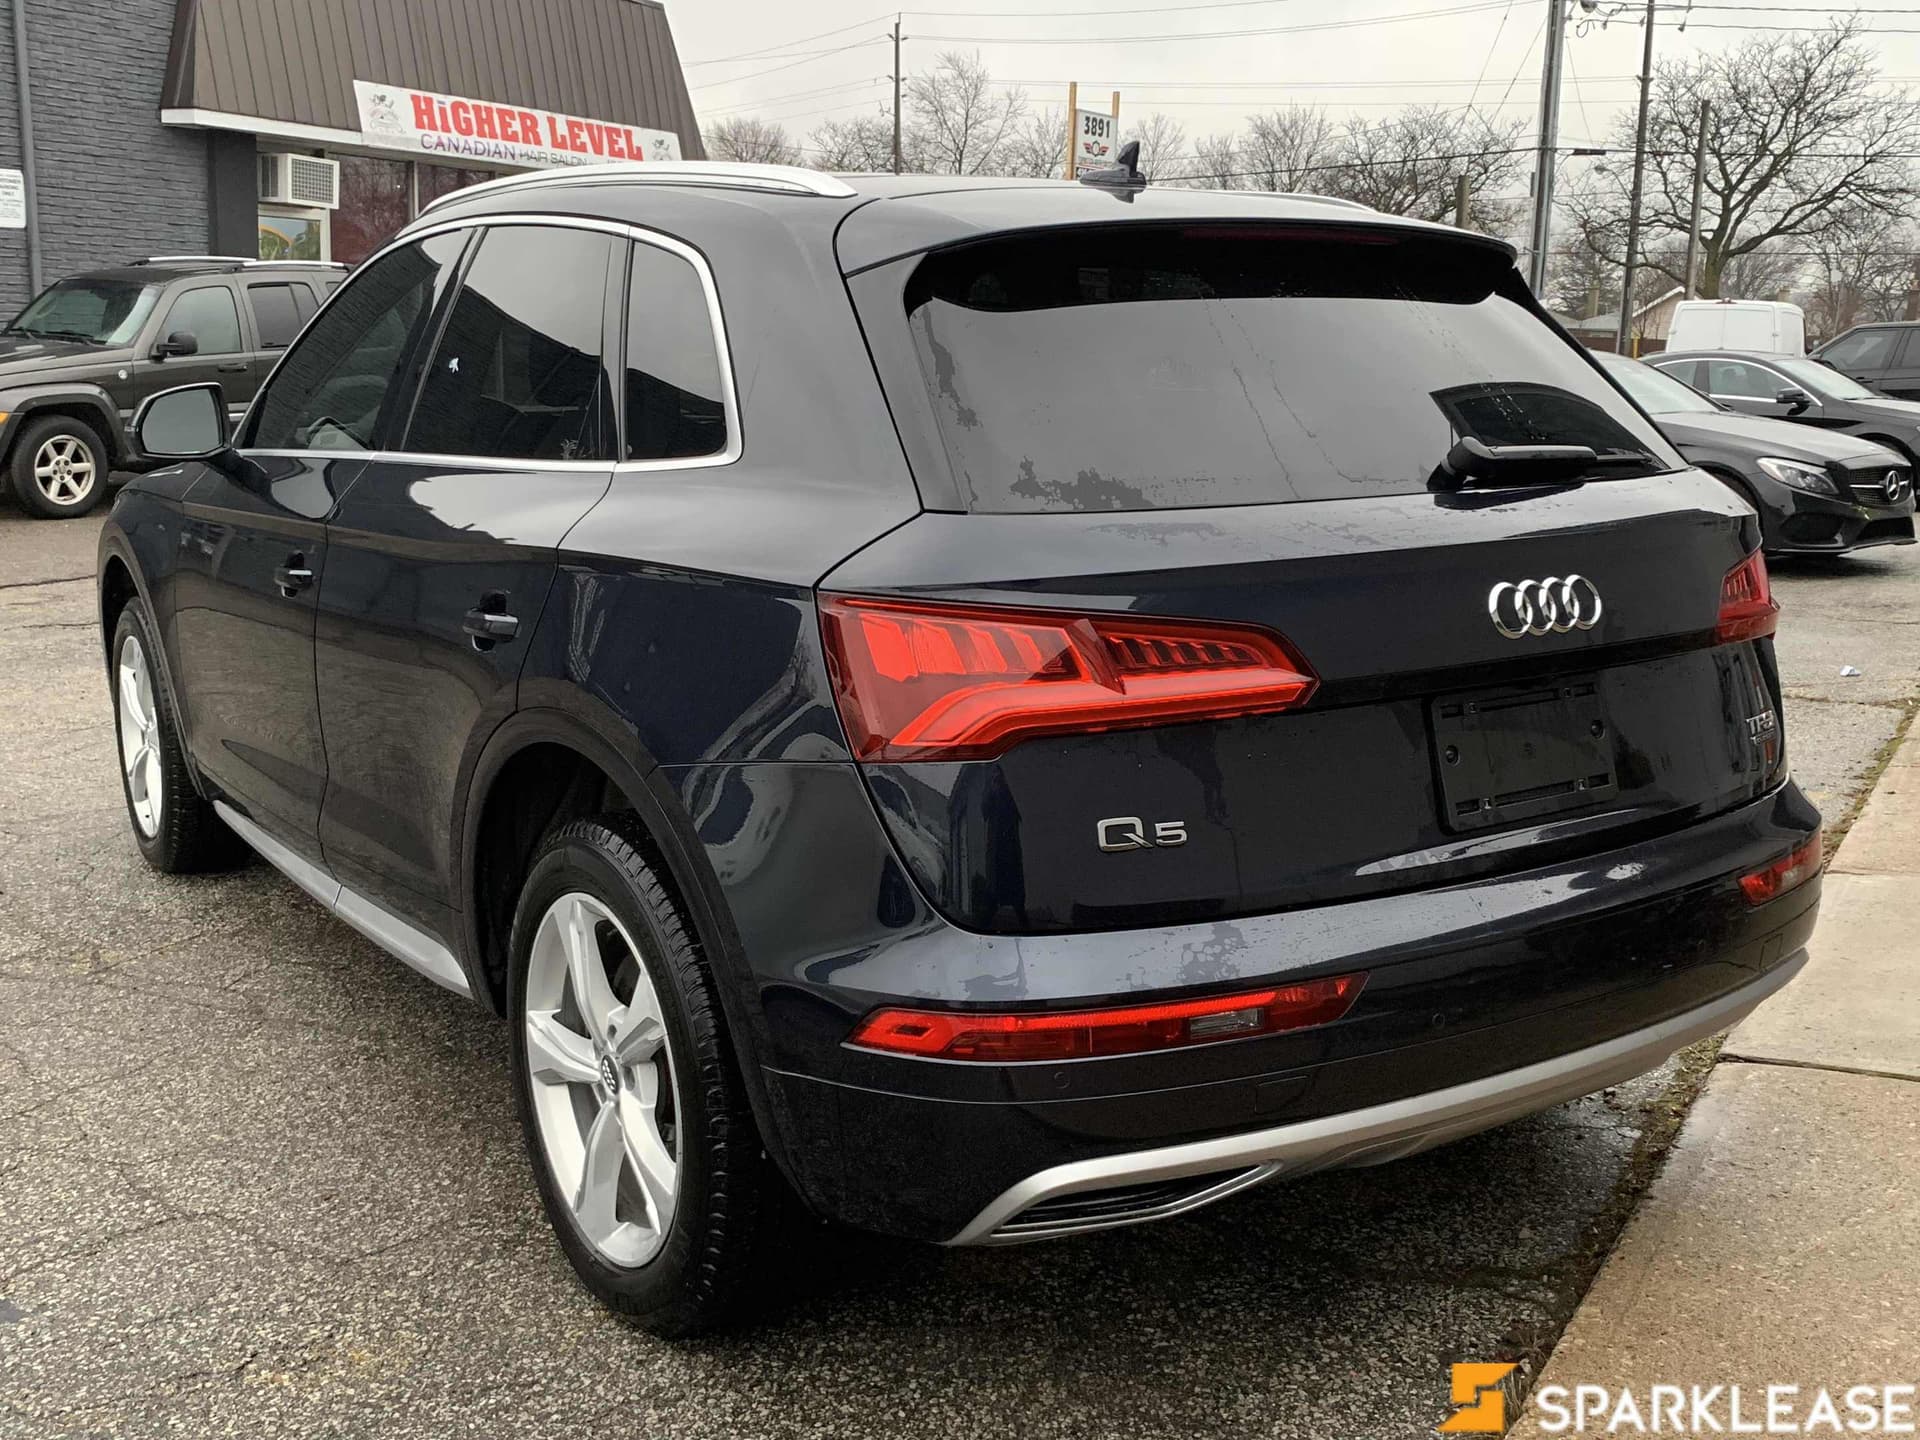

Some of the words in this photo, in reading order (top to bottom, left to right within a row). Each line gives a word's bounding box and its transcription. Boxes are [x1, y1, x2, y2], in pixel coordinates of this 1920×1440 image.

[547, 115, 644, 161] LEVEL
[1084, 116, 1110, 138] 3891
[420, 133, 516, 160] CANADIAN
[1097, 816, 1187, 852] Q5
